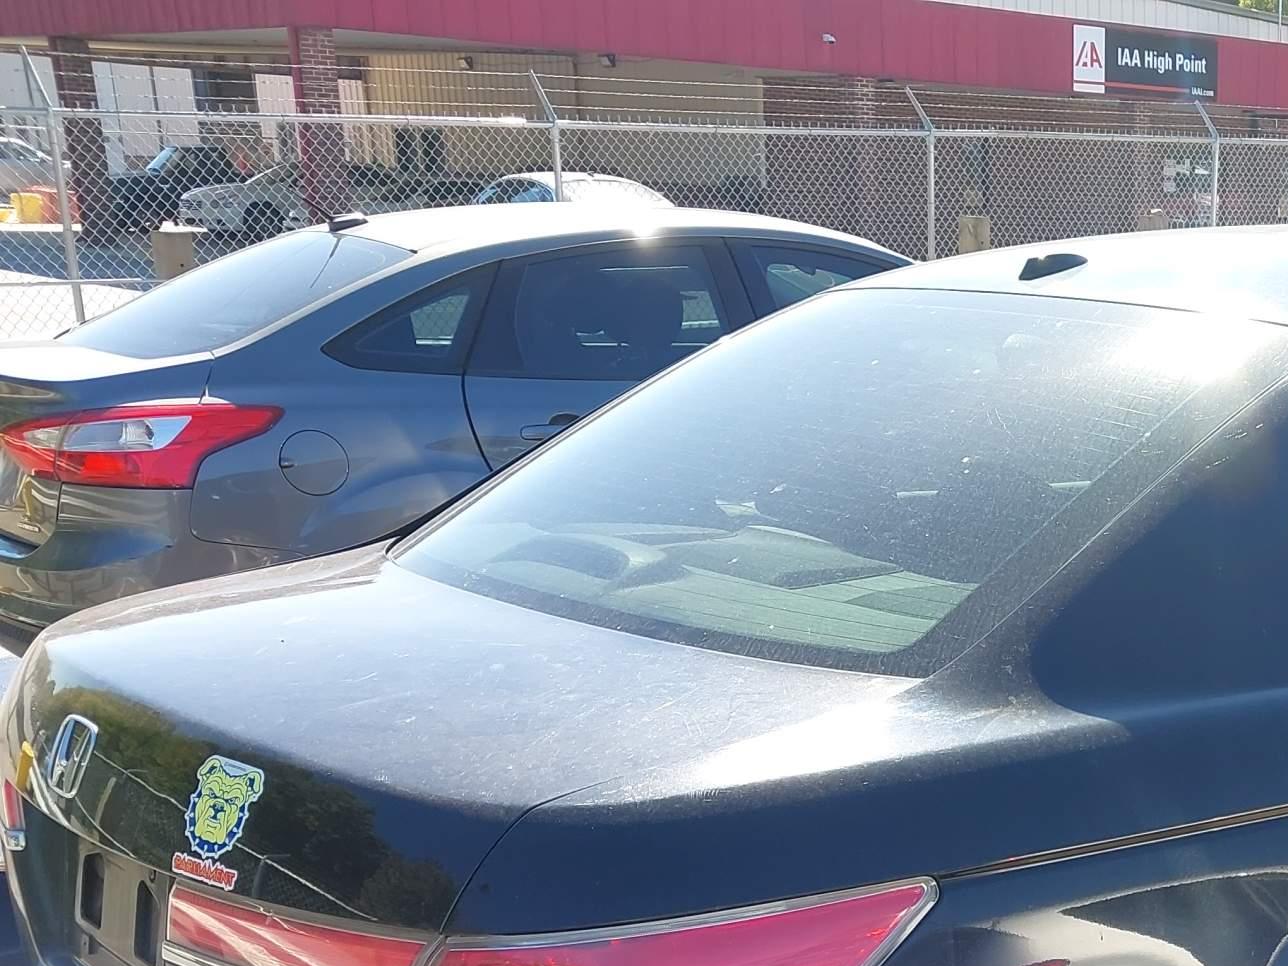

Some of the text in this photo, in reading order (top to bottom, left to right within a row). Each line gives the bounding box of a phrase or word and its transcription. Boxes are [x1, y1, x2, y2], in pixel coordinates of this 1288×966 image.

[1117, 47, 1207, 74] IAA High Point
[174, 853, 237, 889] PARLIAMENT
